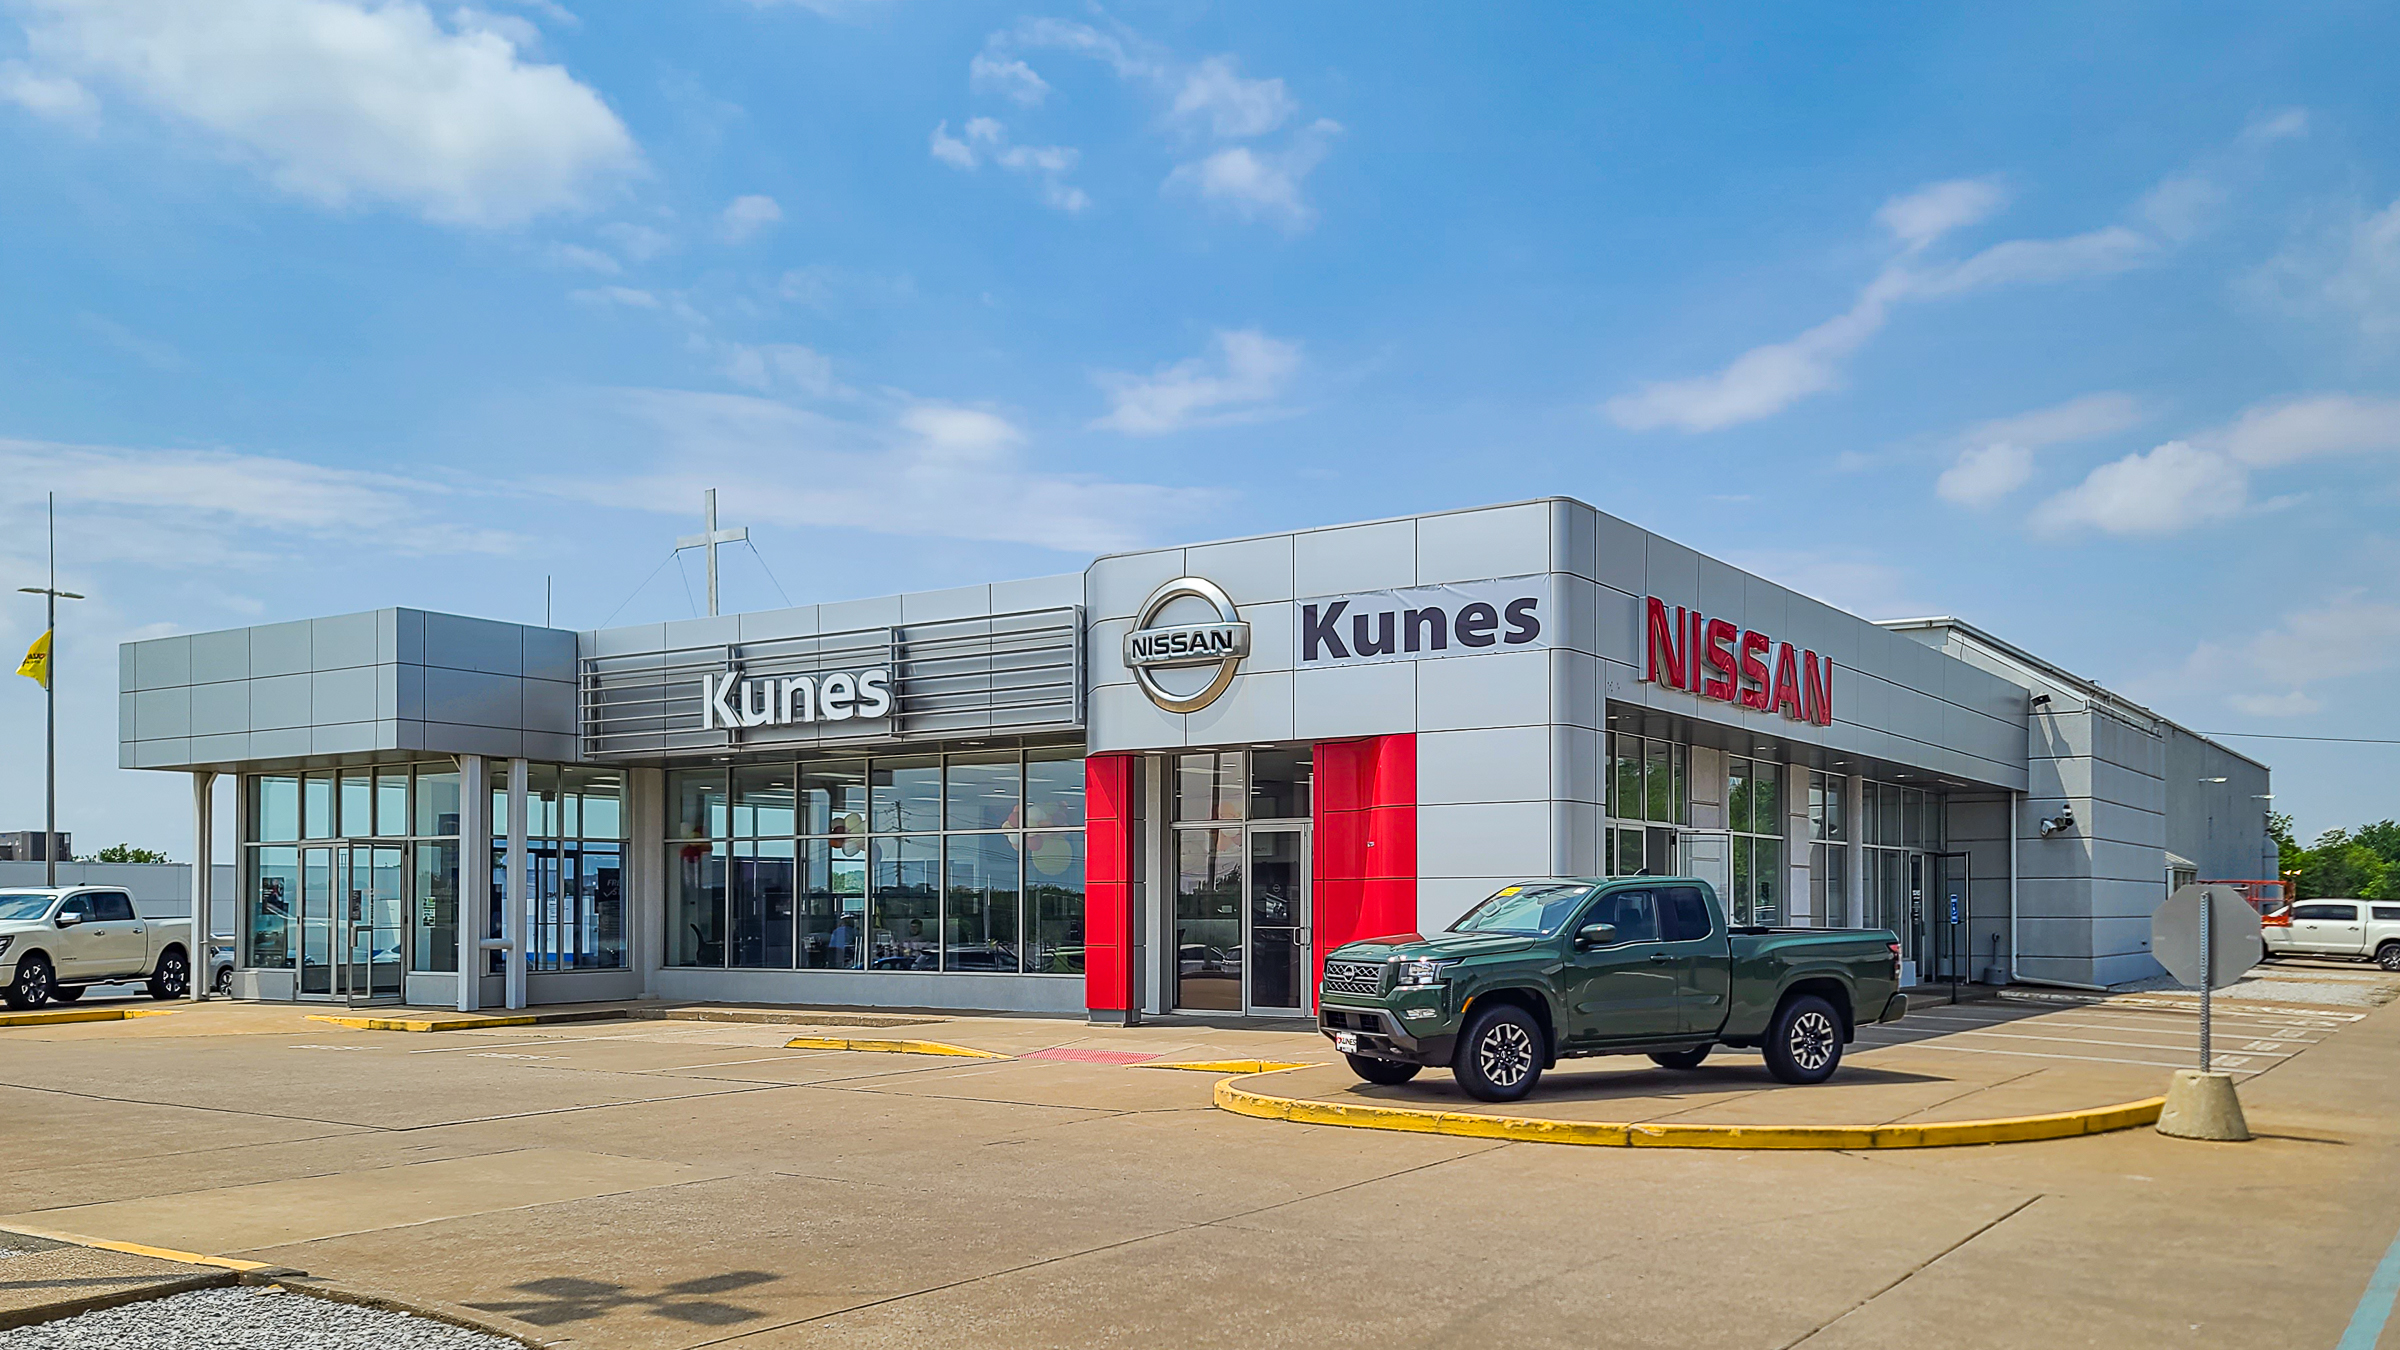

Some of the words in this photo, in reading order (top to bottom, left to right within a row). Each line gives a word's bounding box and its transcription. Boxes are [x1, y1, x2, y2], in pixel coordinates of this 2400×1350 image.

[1131, 630, 1233, 659] NISSAN
[1302, 597, 1541, 662] Kunes
[1645, 595, 1833, 726] NISSAN
[702, 669, 893, 729] Kunes
